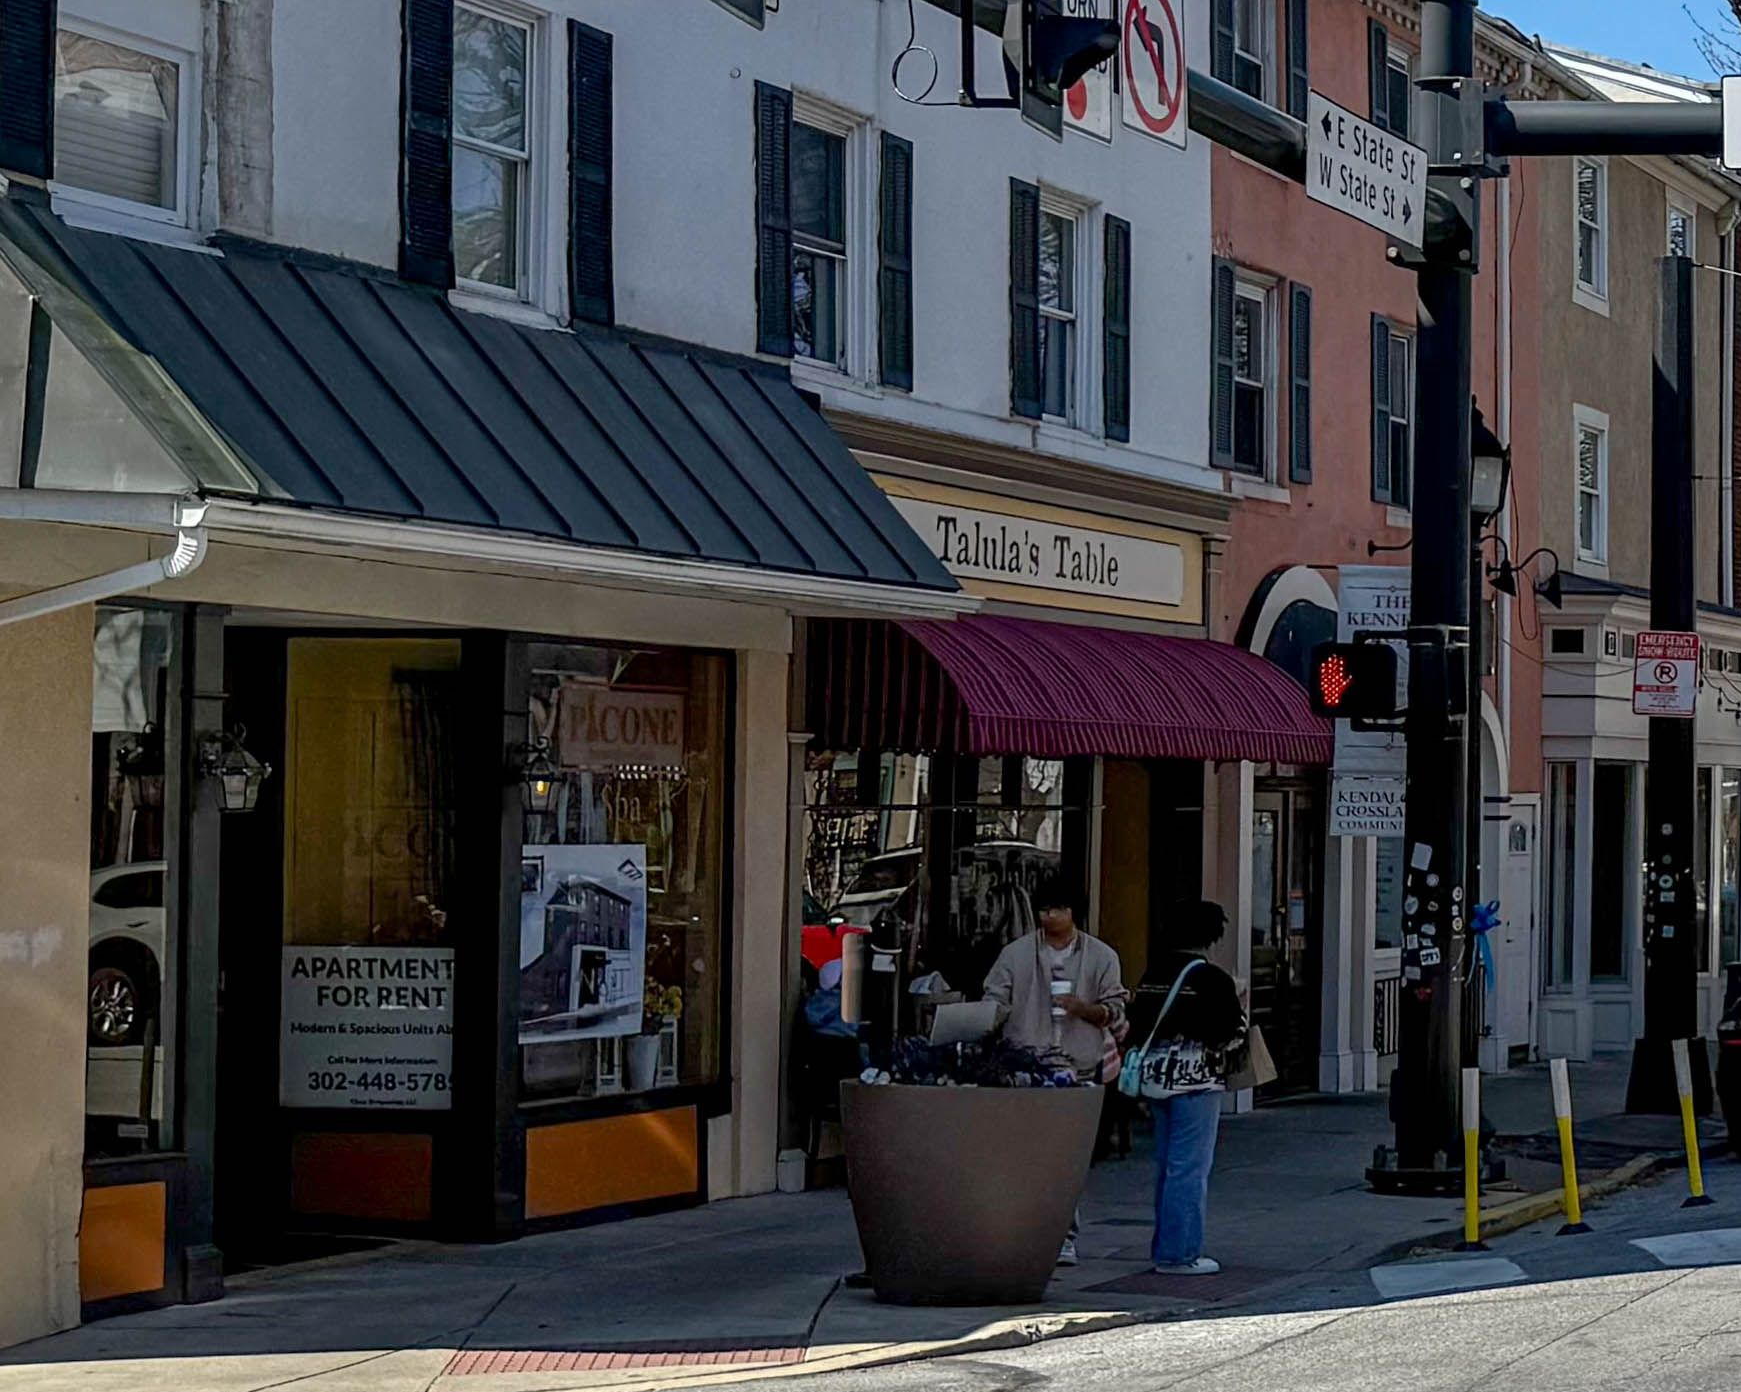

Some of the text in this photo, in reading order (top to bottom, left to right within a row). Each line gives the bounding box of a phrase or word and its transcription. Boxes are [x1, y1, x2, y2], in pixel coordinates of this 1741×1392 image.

[1338, 116, 1415, 185] E State St
[1319, 152, 1395, 220] W State St
[937, 515, 1119, 587] Talula's Table
[290, 1023, 336, 1034] Modern
[338, 1024, 347, 1034] &
[350, 1023, 400, 1035] Spacious
[403, 1024, 434, 1034] Units
[317, 986, 447, 1008] FOR RENT
